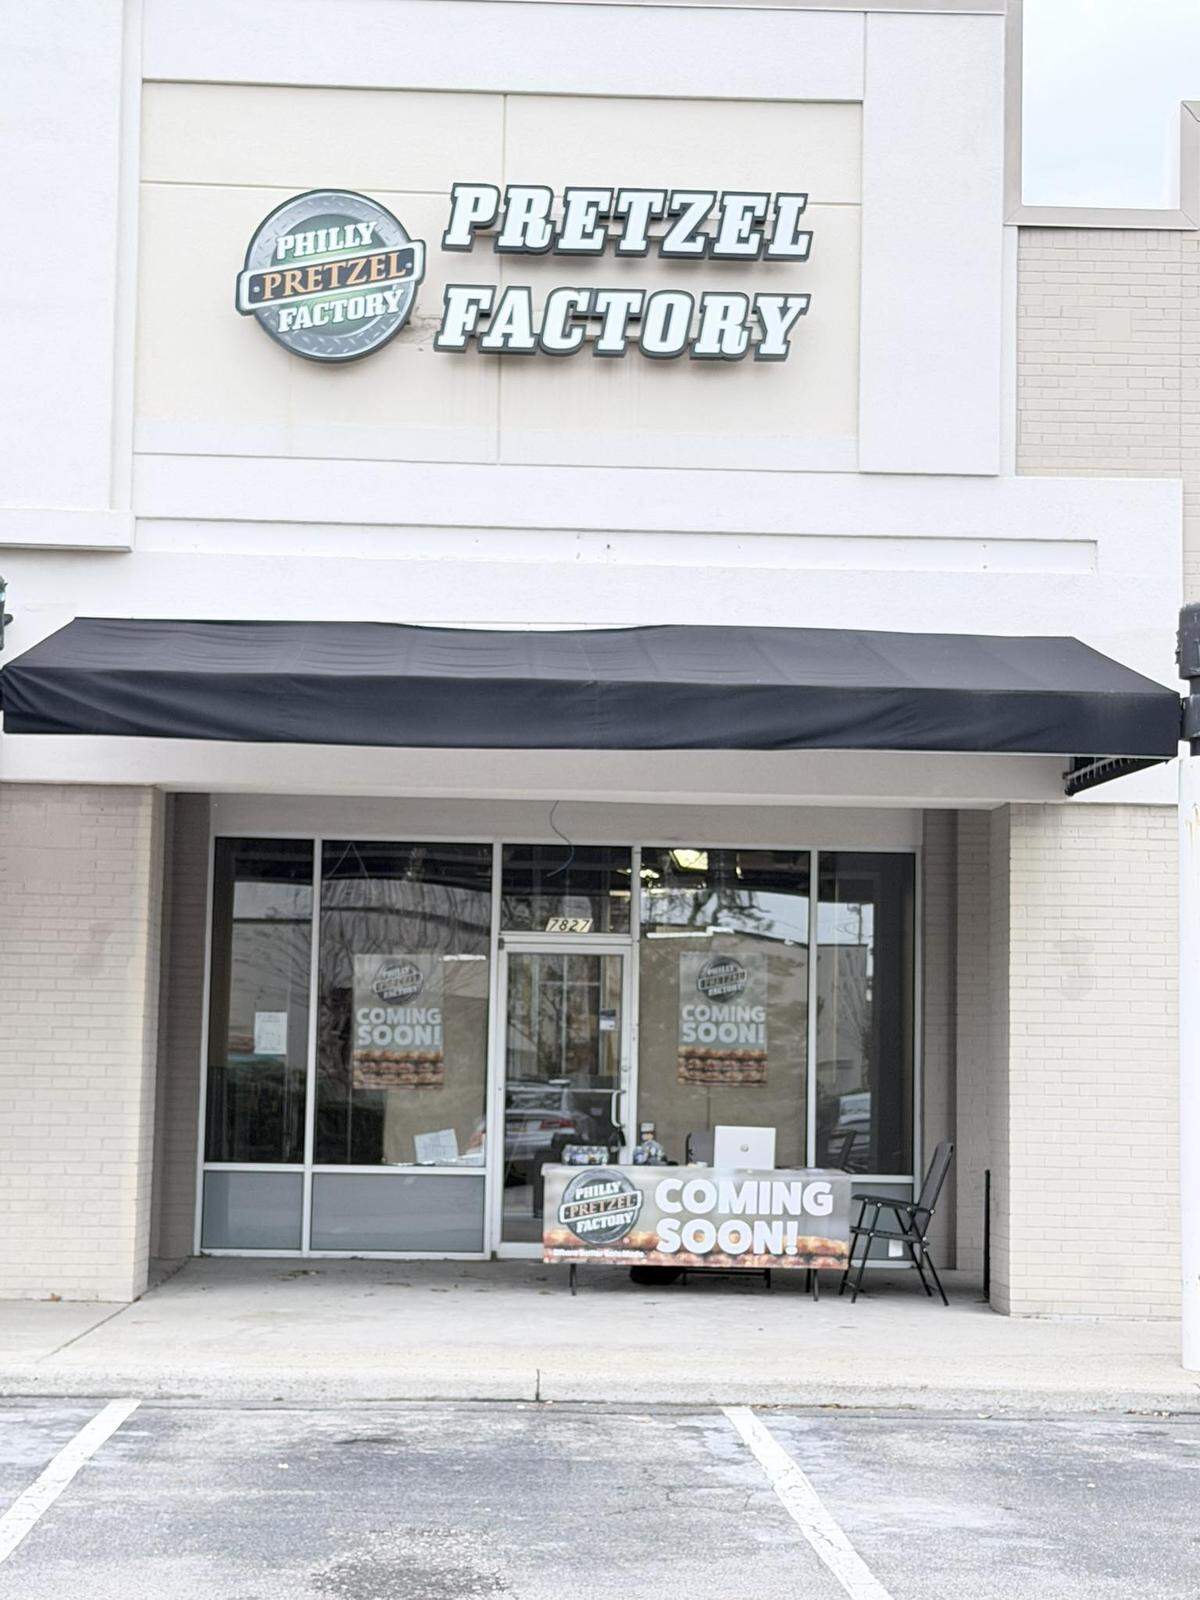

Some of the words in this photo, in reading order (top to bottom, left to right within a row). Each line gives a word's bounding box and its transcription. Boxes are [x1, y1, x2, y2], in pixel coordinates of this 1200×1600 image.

[442, 183, 813, 262] PRETZEL
[276, 222, 377, 260] PHILLY
[262, 253, 407, 300] PRETZEL
[277, 290, 404, 333] FACTORY
[433, 284, 811, 361] FACTORY
[549, 919, 590, 931] 7827
[357, 1008, 442, 1024] COMING
[682, 1004, 766, 1022] COMING
[358, 1024, 441, 1046] SOON!
[682, 1022, 765, 1043] SOON!
[575, 1181, 621, 1200] PHILLY
[655, 1178, 834, 1217] COMING
[569, 1195, 634, 1218] PRETZEL
[576, 1212, 633, 1233] FACTORY
[656, 1218, 799, 1255] SOON!
